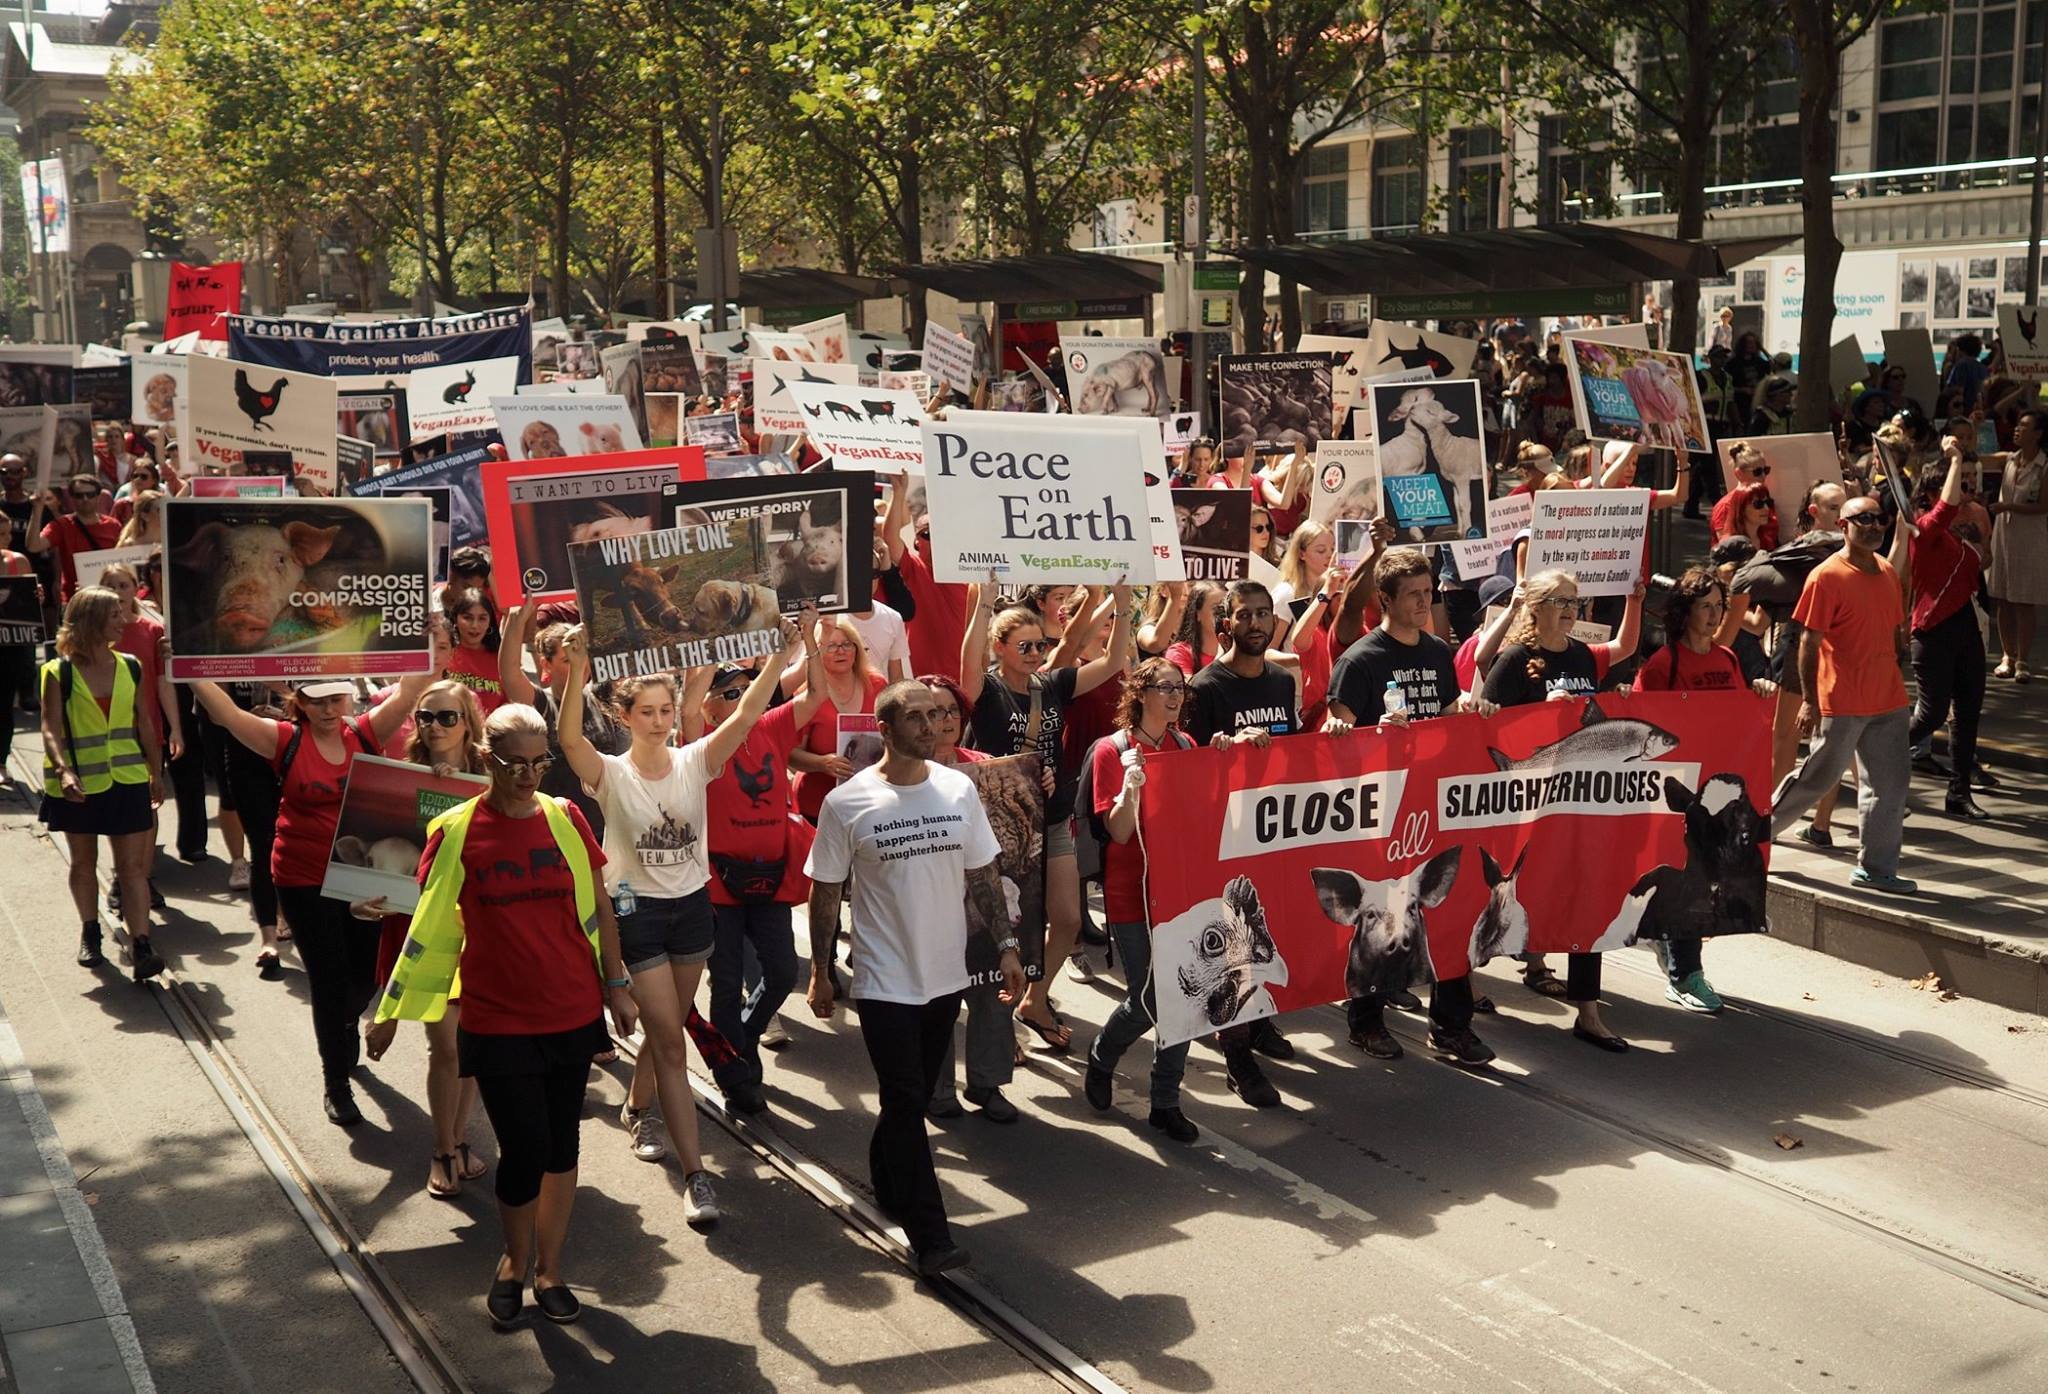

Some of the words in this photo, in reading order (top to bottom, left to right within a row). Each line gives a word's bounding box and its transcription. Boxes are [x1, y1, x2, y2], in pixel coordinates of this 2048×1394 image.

[1860, 294, 1885, 304] soon
[325, 324, 407, 345] Against
[329, 354, 369, 368] protect
[373, 356, 399, 368] your
[402, 352, 439, 364] health
[1229, 363, 1252, 372] MAKE
[1254, 362, 1271, 371] THE
[1271, 360, 1324, 370] CONNECTION
[1588, 379, 1620, 393] MEET
[343, 400, 378, 409] VEGAN
[1593, 390, 1626, 404] YOUR
[519, 404, 538, 412] LOVE
[1601, 402, 1633, 416] MEAT
[762, 416, 806, 430] Vegan
[204, 429, 217, 437] you
[219, 431, 234, 440] love
[236, 434, 267, 447] animals,
[269, 440, 289, 451] don't
[291, 445, 303, 453] eat
[305, 447, 328, 457] them.
[934, 433, 1071, 481] Peace
[1322, 449, 1343, 457] YOUR
[354, 481, 380, 496] WHOSE
[380, 475, 398, 490] BABY
[396, 468, 423, 483] SHOULD
[423, 463, 434, 474] DIE
[433, 460, 446, 471] FOR
[446, 454, 465, 468] YOUR
[515, 487, 523, 500] I
[534, 482, 582, 498] WANT
[592, 479, 616, 493] TO
[626, 474, 672, 490] LIVE
[1391, 477, 1430, 491] MEET
[1038, 487, 1071, 504] on
[1396, 489, 1436, 504] YOUR
[711, 506, 759, 521] WE'RE
[765, 500, 812, 515] SORRY
[1403, 501, 1442, 516] MEAT
[1502, 506, 1520, 515] nation
[1521, 503, 1530, 512] and
[1558, 504, 1592, 520] greatness
[1593, 504, 1601, 517] of
[1602, 506, 1607, 516] a
[1608, 504, 1630, 517] nation
[1630, 503, 1643, 516] and
[998, 495, 1136, 542] Earth
[1500, 523, 1511, 532] can
[1511, 521, 1518, 529] be
[1534, 528, 1544, 540] its
[1545, 527, 1565, 540] moral
[1566, 527, 1596, 542] progress
[1598, 528, 1611, 539] can
[1612, 525, 1619, 538] be
[1620, 524, 1643, 539] judged
[600, 535, 642, 566] WHY
[647, 527, 690, 560] LOVE
[696, 521, 733, 552] ONE
[1464, 546, 1472, 556] by
[1472, 544, 1482, 553] the
[1482, 543, 1493, 551] way
[958, 552, 1010, 564] ANIMAL
[1020, 554, 1130, 571] VeganEasy.org
[1542, 550, 1551, 564] by
[1552, 550, 1564, 562] the
[1565, 552, 1579, 564] way
[1580, 549, 1590, 562] its
[1591, 549, 1617, 561] animals
[1618, 550, 1630, 560] are
[1184, 557, 1204, 579] TO
[1208, 557, 1240, 579] LIVE
[1606, 568, 1631, 582] Gandhi
[337, 574, 425, 590] CHOOSE
[289, 590, 425, 608] COMPASSION
[381, 606, 424, 622] FOR
[13, 627, 39, 643] LIVE
[379, 621, 424, 637] PIGS
[1571, 629, 1592, 639] ILLING
[1593, 632, 1603, 640] ME
[276, 658, 328, 667] MELBOURNE
[593, 653, 630, 683] BUT
[634, 646, 676, 675] KILL
[677, 640, 711, 668] THE
[714, 627, 781, 663] OTHER?
[300, 665, 322, 673] SAVE
[1392, 668, 1421, 683] What's
[1407, 685, 1419, 698] the
[1420, 683, 1438, 697] dark
[1234, 706, 1288, 727] ANIMAL
[1445, 770, 1661, 818] SLAUGHTERHOUSES
[1255, 783, 1379, 844] CLOSE
[873, 816, 920, 834] Nothing
[922, 814, 963, 826] humane
[876, 832, 925, 849] happens
[927, 829, 938, 839] in
[1387, 810, 1433, 862] all
[637, 850, 664, 864] NEW
[879, 843, 963, 862] slaughterhouse.
[989, 970, 1004, 982] to
